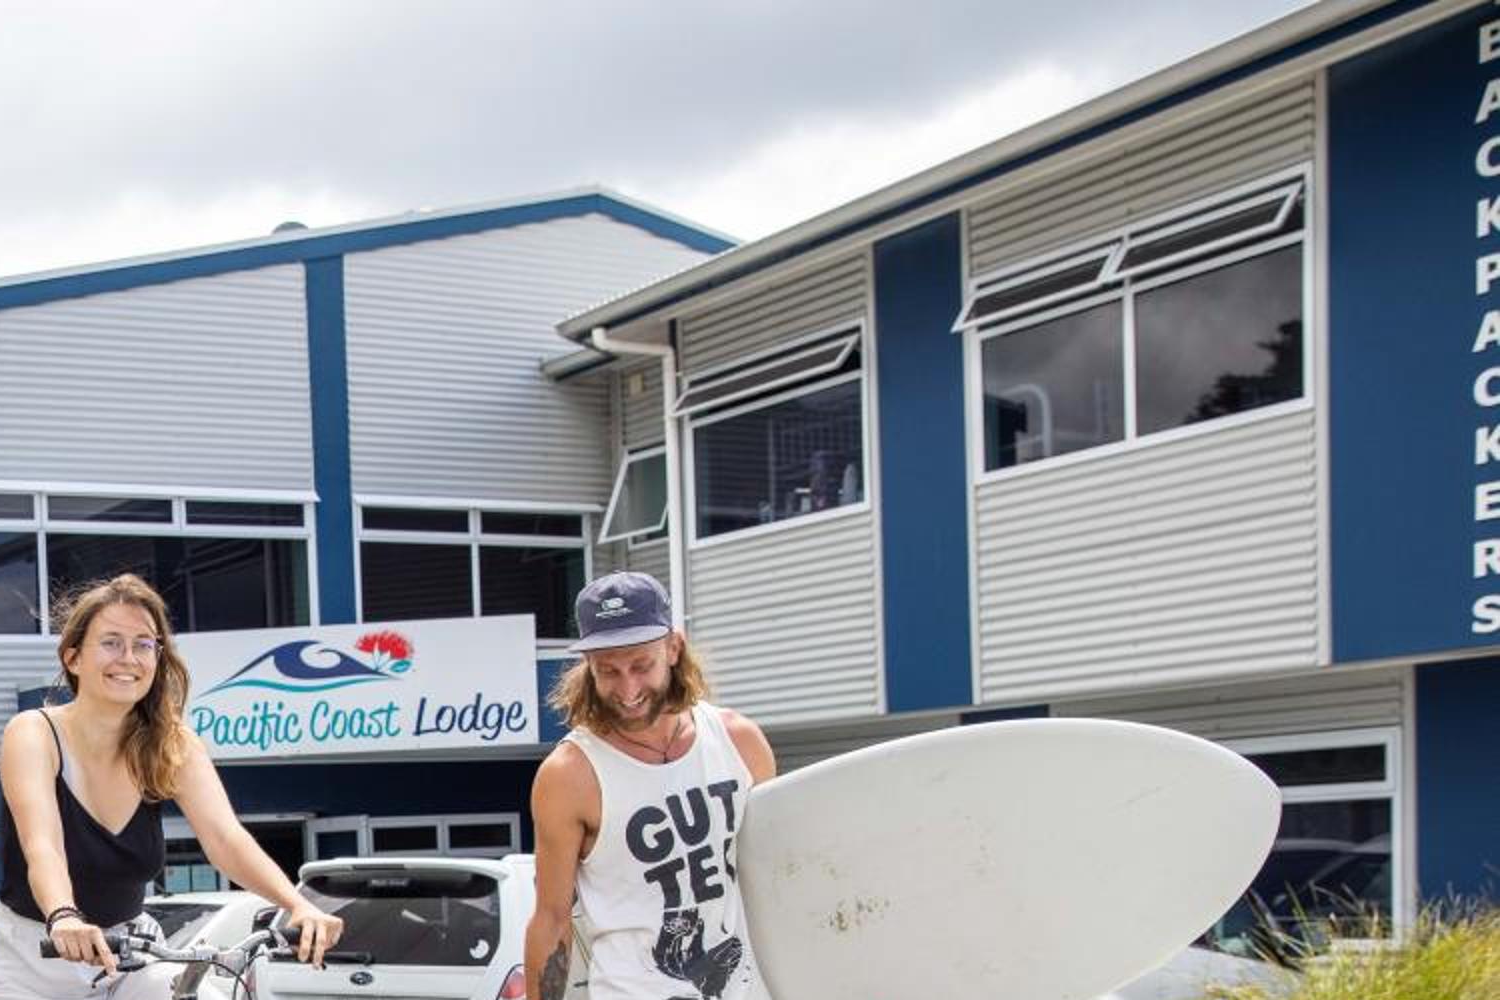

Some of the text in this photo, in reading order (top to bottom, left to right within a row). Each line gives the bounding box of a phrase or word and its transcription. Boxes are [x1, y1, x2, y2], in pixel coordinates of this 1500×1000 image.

[1471, 18, 1500, 634] BACKPACKERS
[190, 692, 527, 750] Pacific Coast Lodge
[625, 779, 739, 863] GUT
[643, 837, 737, 909] TE
